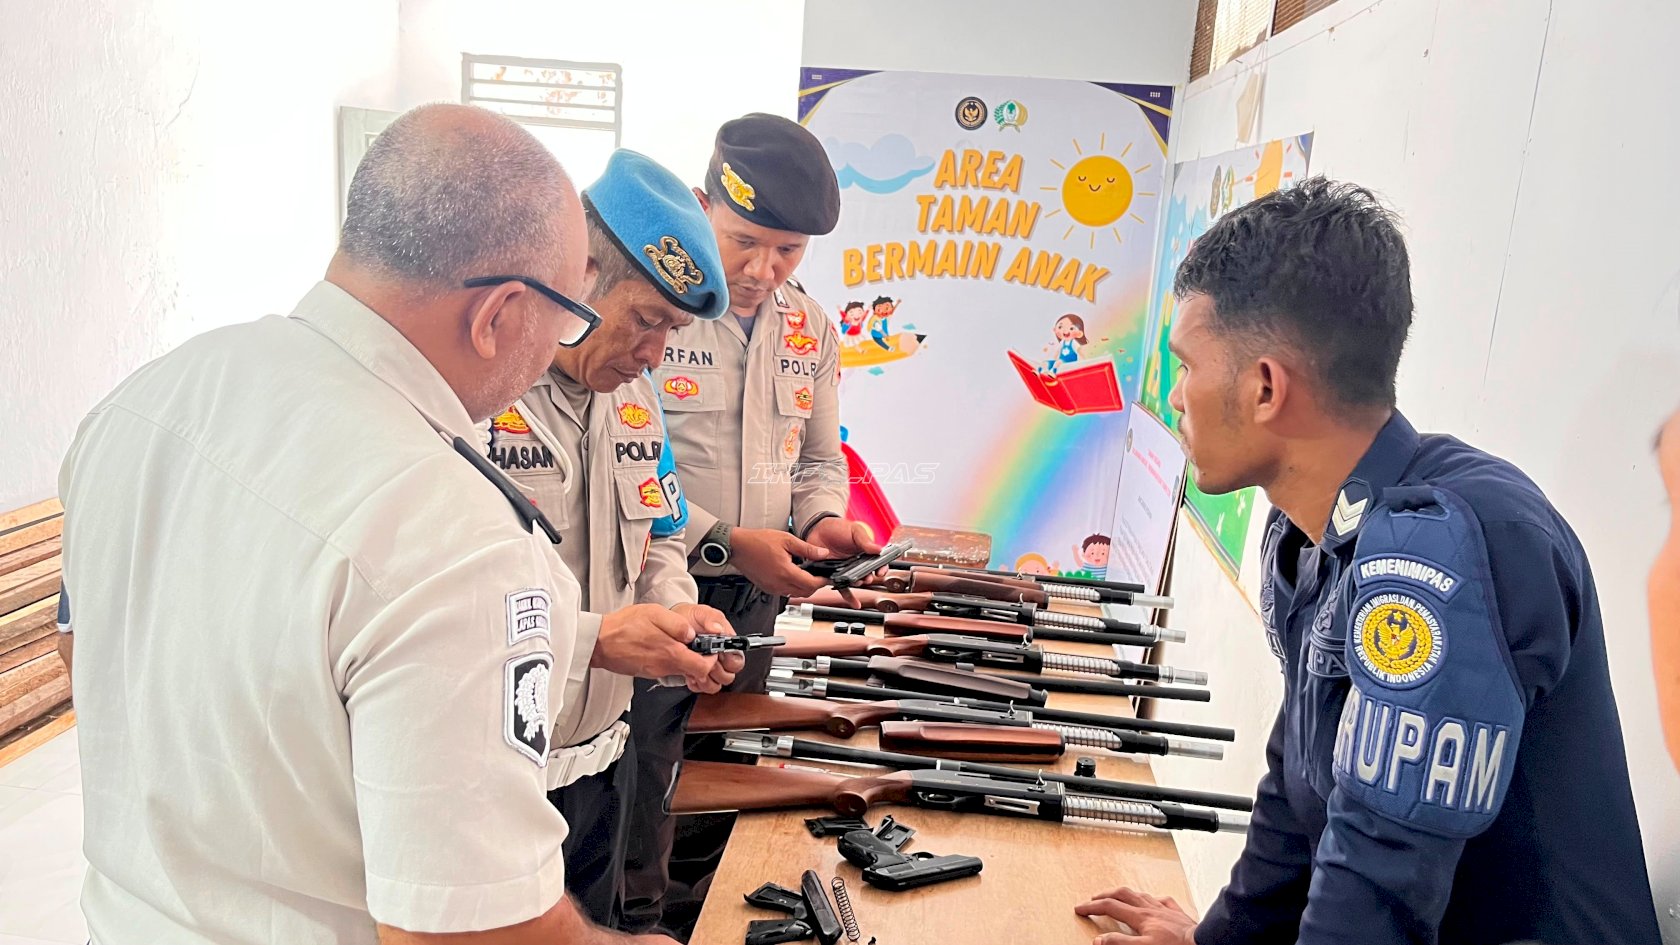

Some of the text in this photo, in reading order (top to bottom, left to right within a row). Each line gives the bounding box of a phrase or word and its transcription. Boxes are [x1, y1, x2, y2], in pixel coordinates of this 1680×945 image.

[933, 149, 1024, 193] AREA
[916, 194, 1041, 238] TAMAN
[842, 240, 1110, 302] BERMAIN ANAK
[663, 346, 713, 366] RFAN
[780, 359, 817, 378] POLR
[491, 445, 554, 470] HASAN
[615, 441, 662, 463] POLR
[1360, 558, 1454, 592] KEMENIMIPAS
[1353, 602, 1373, 644] KEMENTERIAN
[1400, 595, 1416, 609] DAN
[1354, 644, 1434, 684] REPUBLIK INDONESIA
